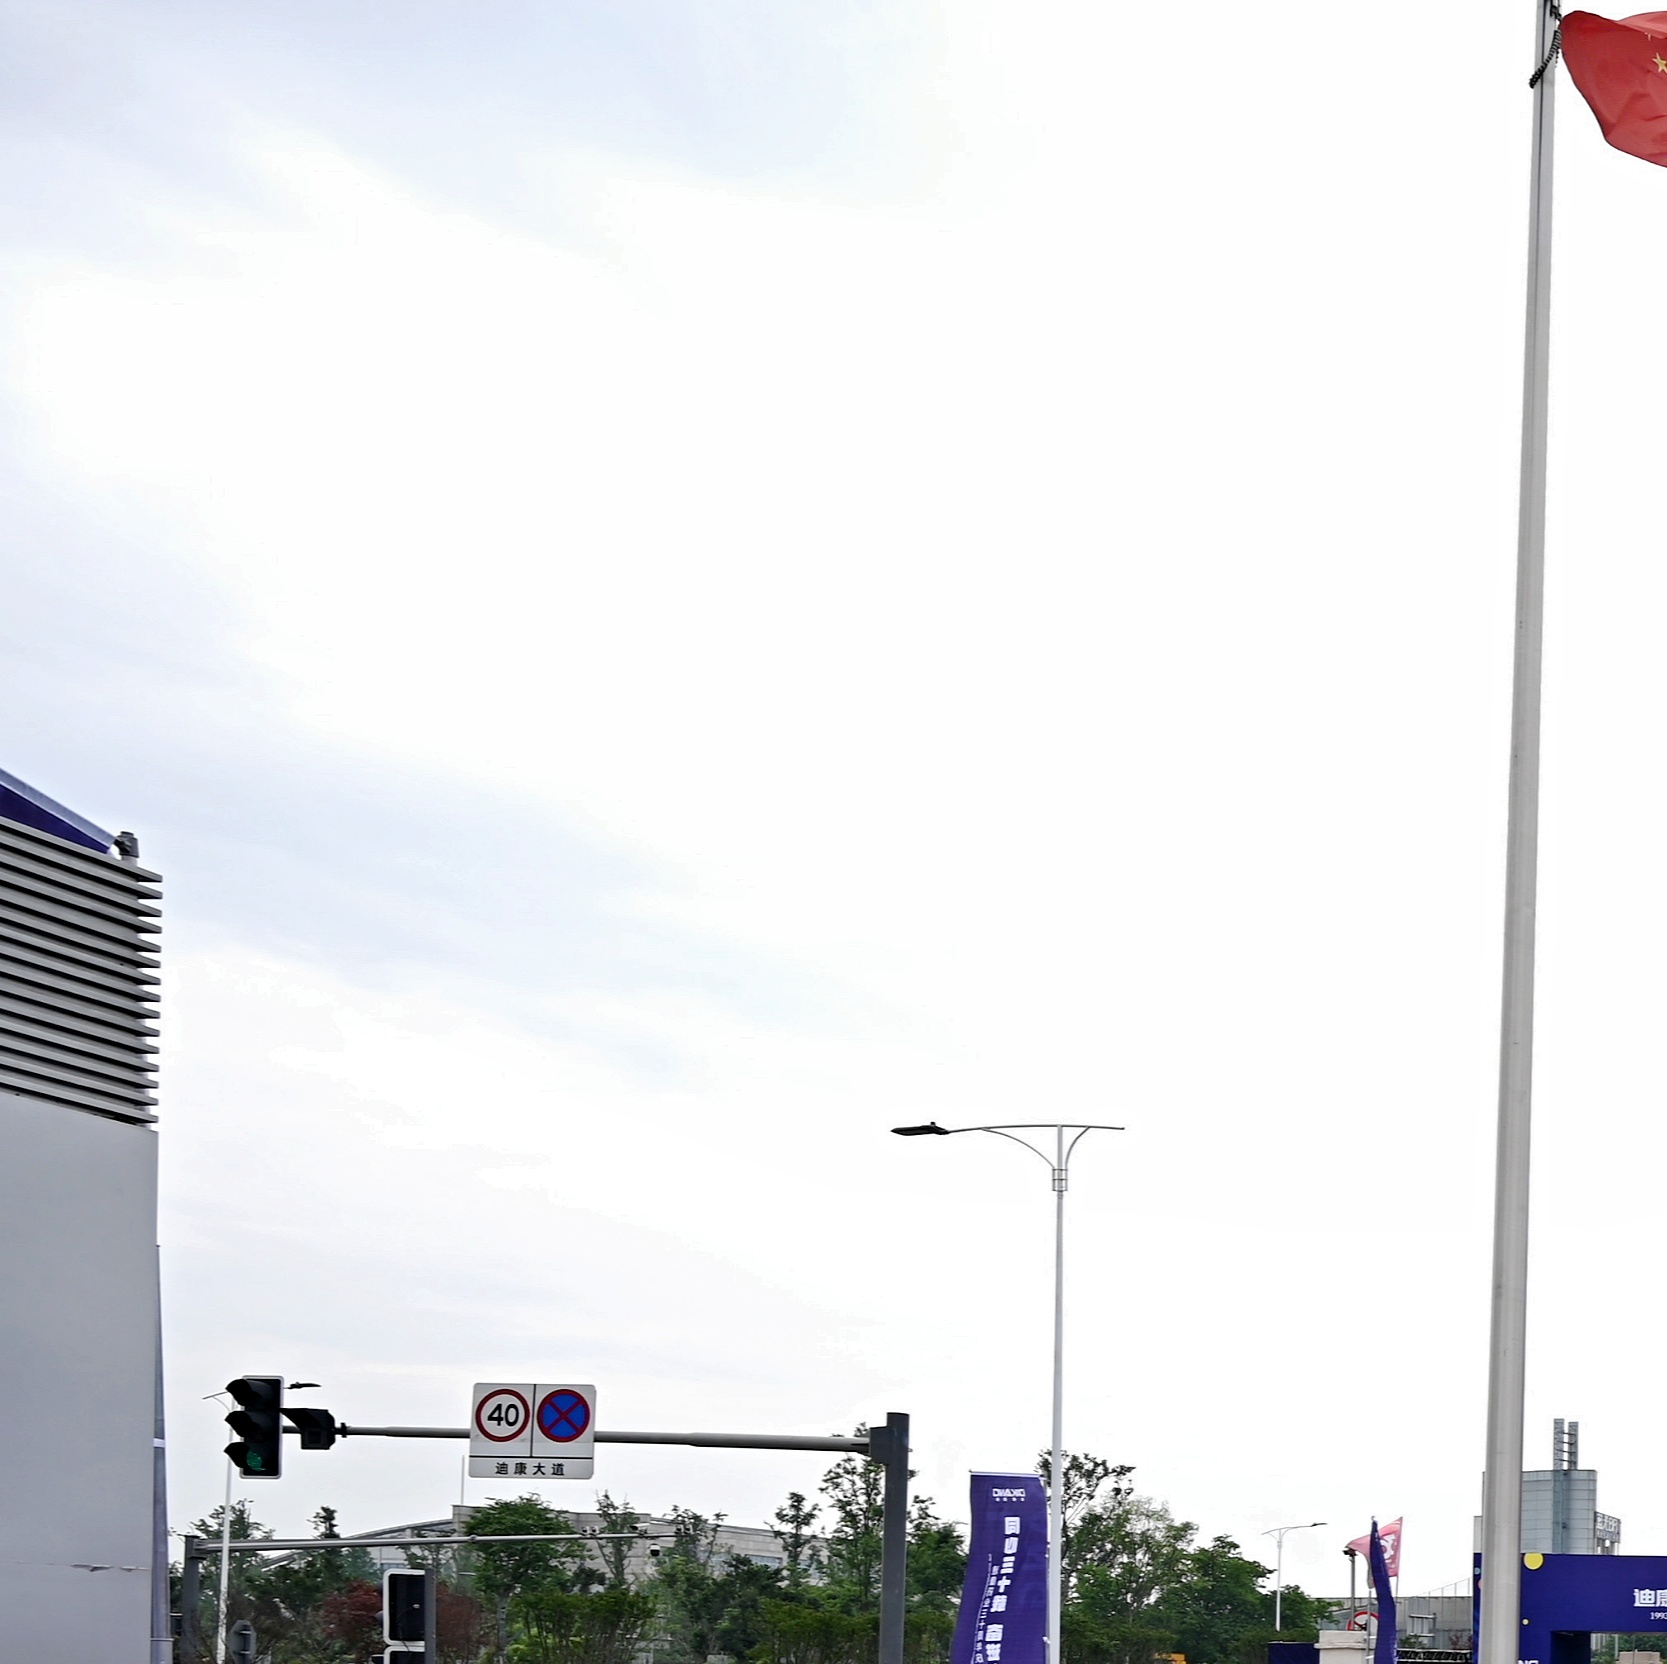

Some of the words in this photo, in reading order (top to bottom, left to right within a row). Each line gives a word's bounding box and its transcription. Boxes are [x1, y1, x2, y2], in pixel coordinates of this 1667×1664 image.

[487, 1403, 519, 1427] 40
[495, 1462, 565, 1476] 迪康大道
